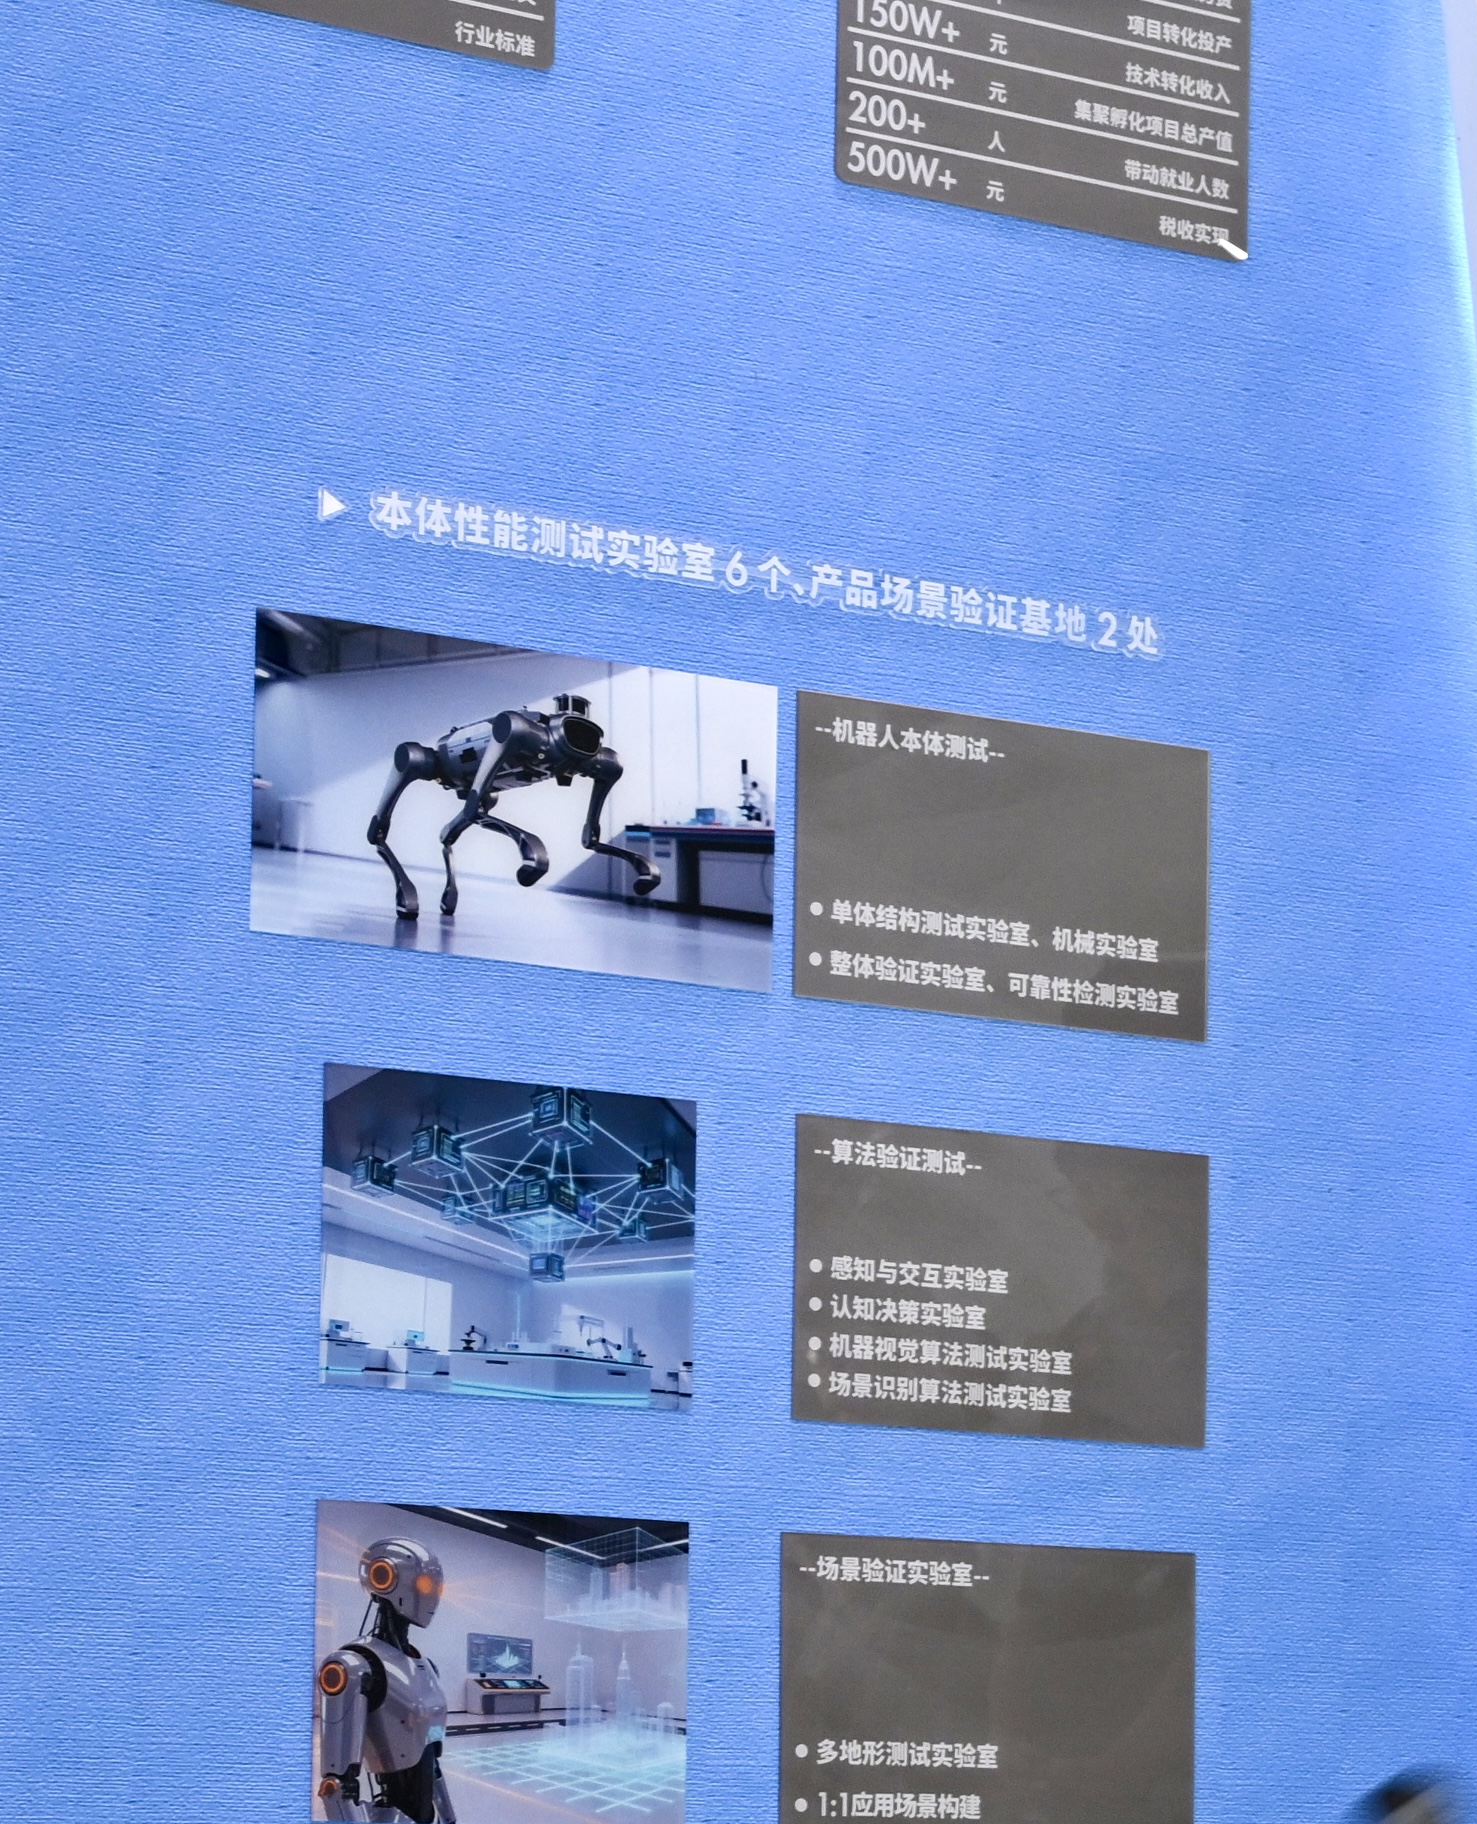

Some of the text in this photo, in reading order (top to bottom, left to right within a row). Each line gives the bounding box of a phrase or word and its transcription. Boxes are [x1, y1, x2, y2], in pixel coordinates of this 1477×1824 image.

[455, 20, 536, 57] 行业标准
[852, 0, 1232, 105] 150W+ 元 技术转化收入
[1127, 14, 1233, 55] 项目转化投产
[852, 40, 1234, 153] 100M+ 元 集聚孵化项目总产值
[848, 90, 1231, 200] 200+ 人 带动就业人数
[847, 141, 958, 193] 500W+
[986, 180, 1005, 202] 元
[830, 1256, 1009, 1294] 感知与交互实验室
[830, 1294, 986, 1330] 认知决策实验室
[829, 1333, 1072, 1375] 机器视觉算法测试实验室
[828, 1371, 1072, 1413] 场景识别算法测试实验室
[816, 1739, 999, 1769] 多地形测试实验室
[817, 1792, 981, 1820] 1:1应用场景构建
